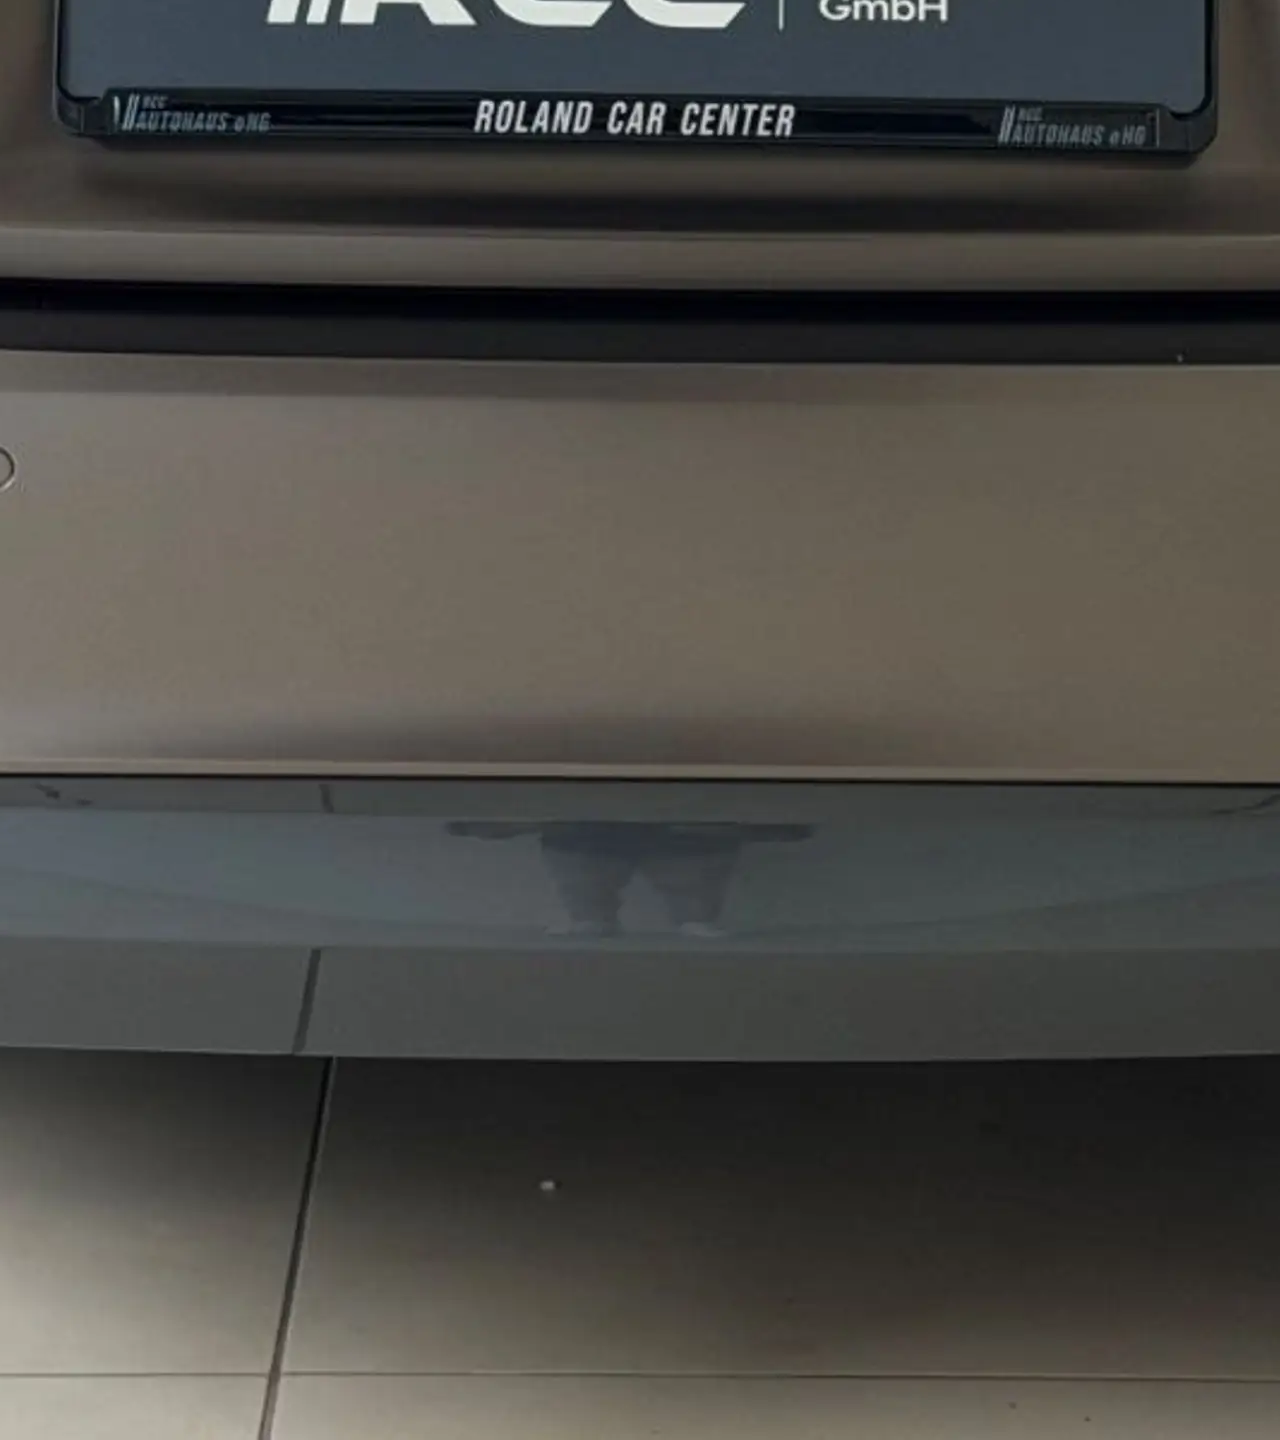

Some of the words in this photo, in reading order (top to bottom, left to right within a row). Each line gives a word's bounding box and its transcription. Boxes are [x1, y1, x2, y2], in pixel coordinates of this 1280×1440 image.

[135, 111, 231, 132] AUTOHAUS
[473, 99, 594, 134] ROLAND
[606, 100, 668, 136] CAR
[680, 102, 796, 138] CENTER
[1011, 122, 1106, 146] AUTOHAUS
